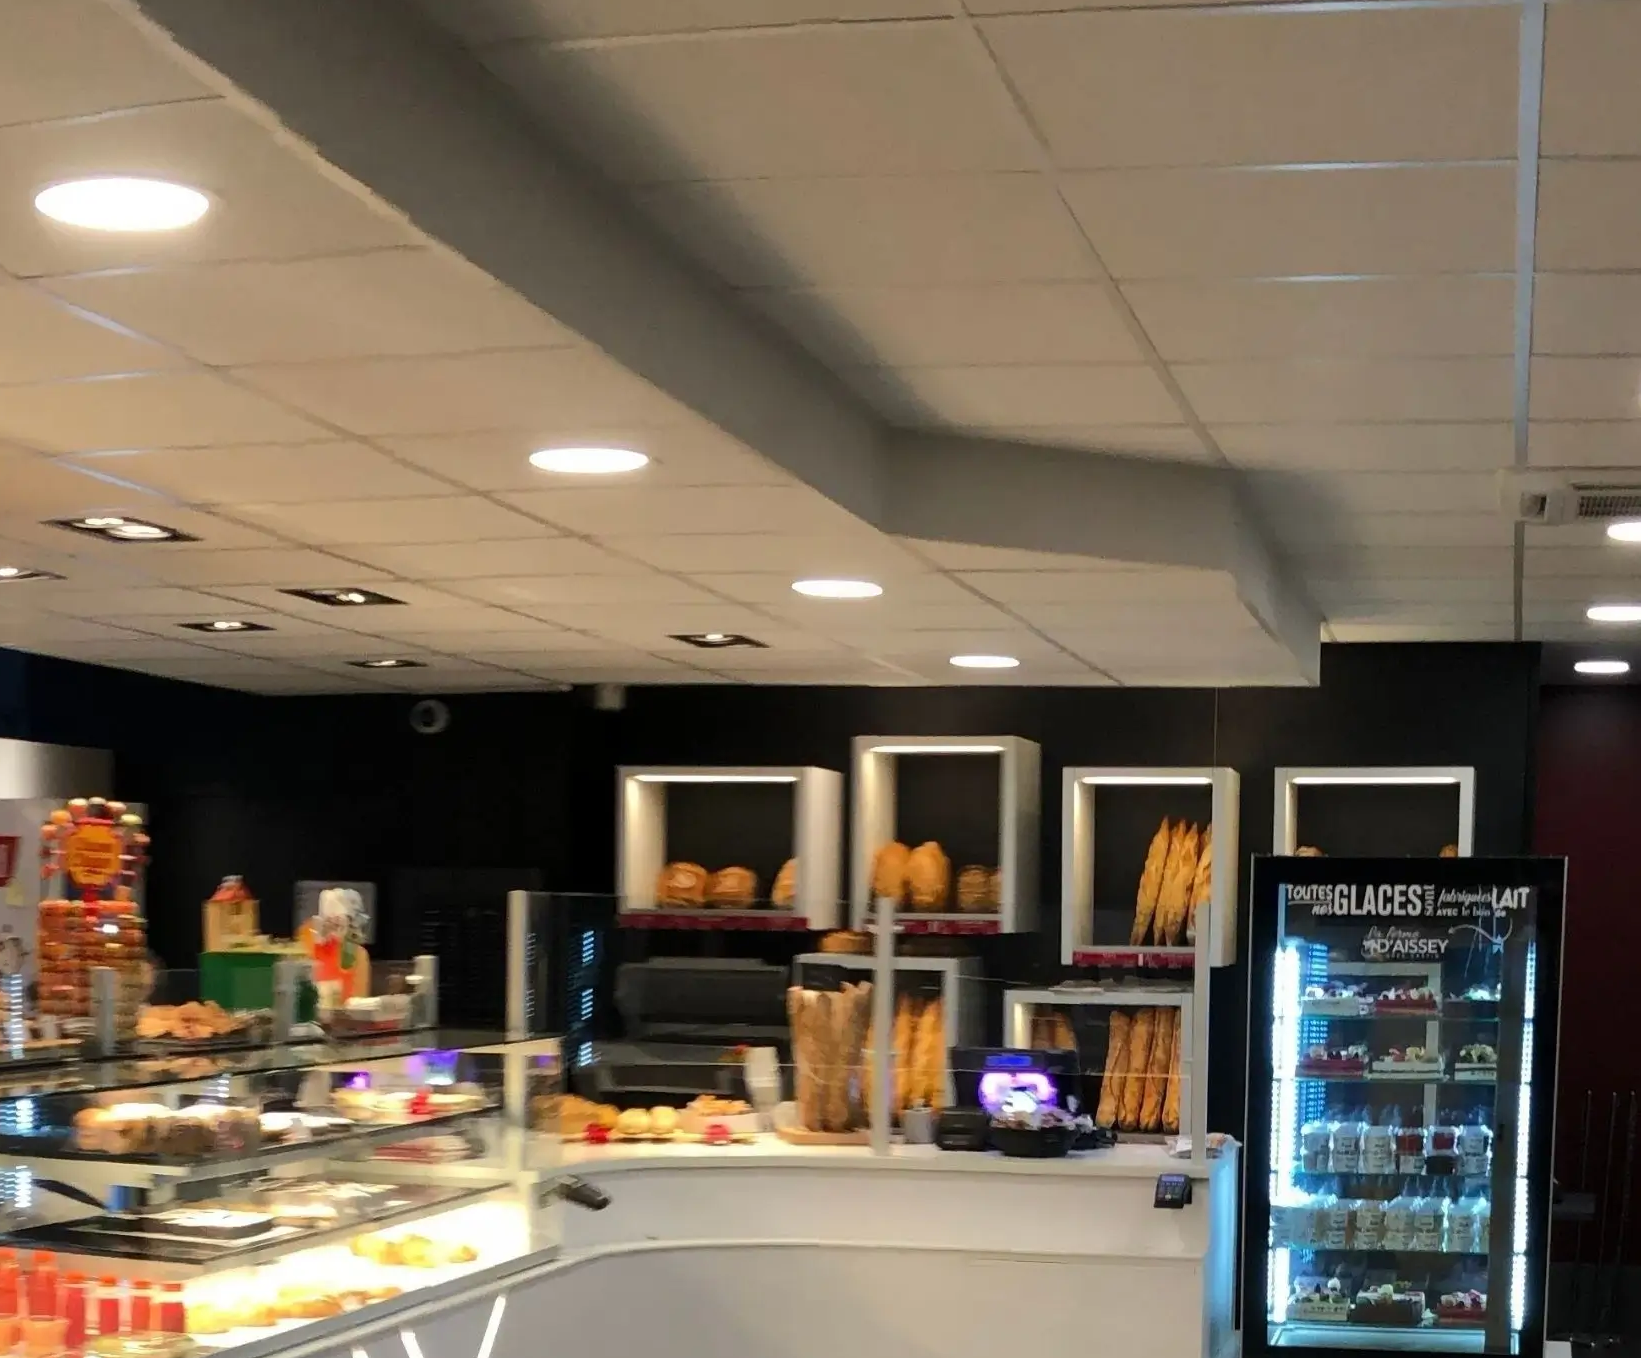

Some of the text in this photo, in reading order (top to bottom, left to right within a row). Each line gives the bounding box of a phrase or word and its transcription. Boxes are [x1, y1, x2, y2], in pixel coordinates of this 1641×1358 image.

[1287, 883, 1333, 900] TOUTES
[1333, 883, 1423, 917] GLACES
[1491, 886, 1530, 911] LAIT
[1377, 938, 1450, 954] D'AISSEY
